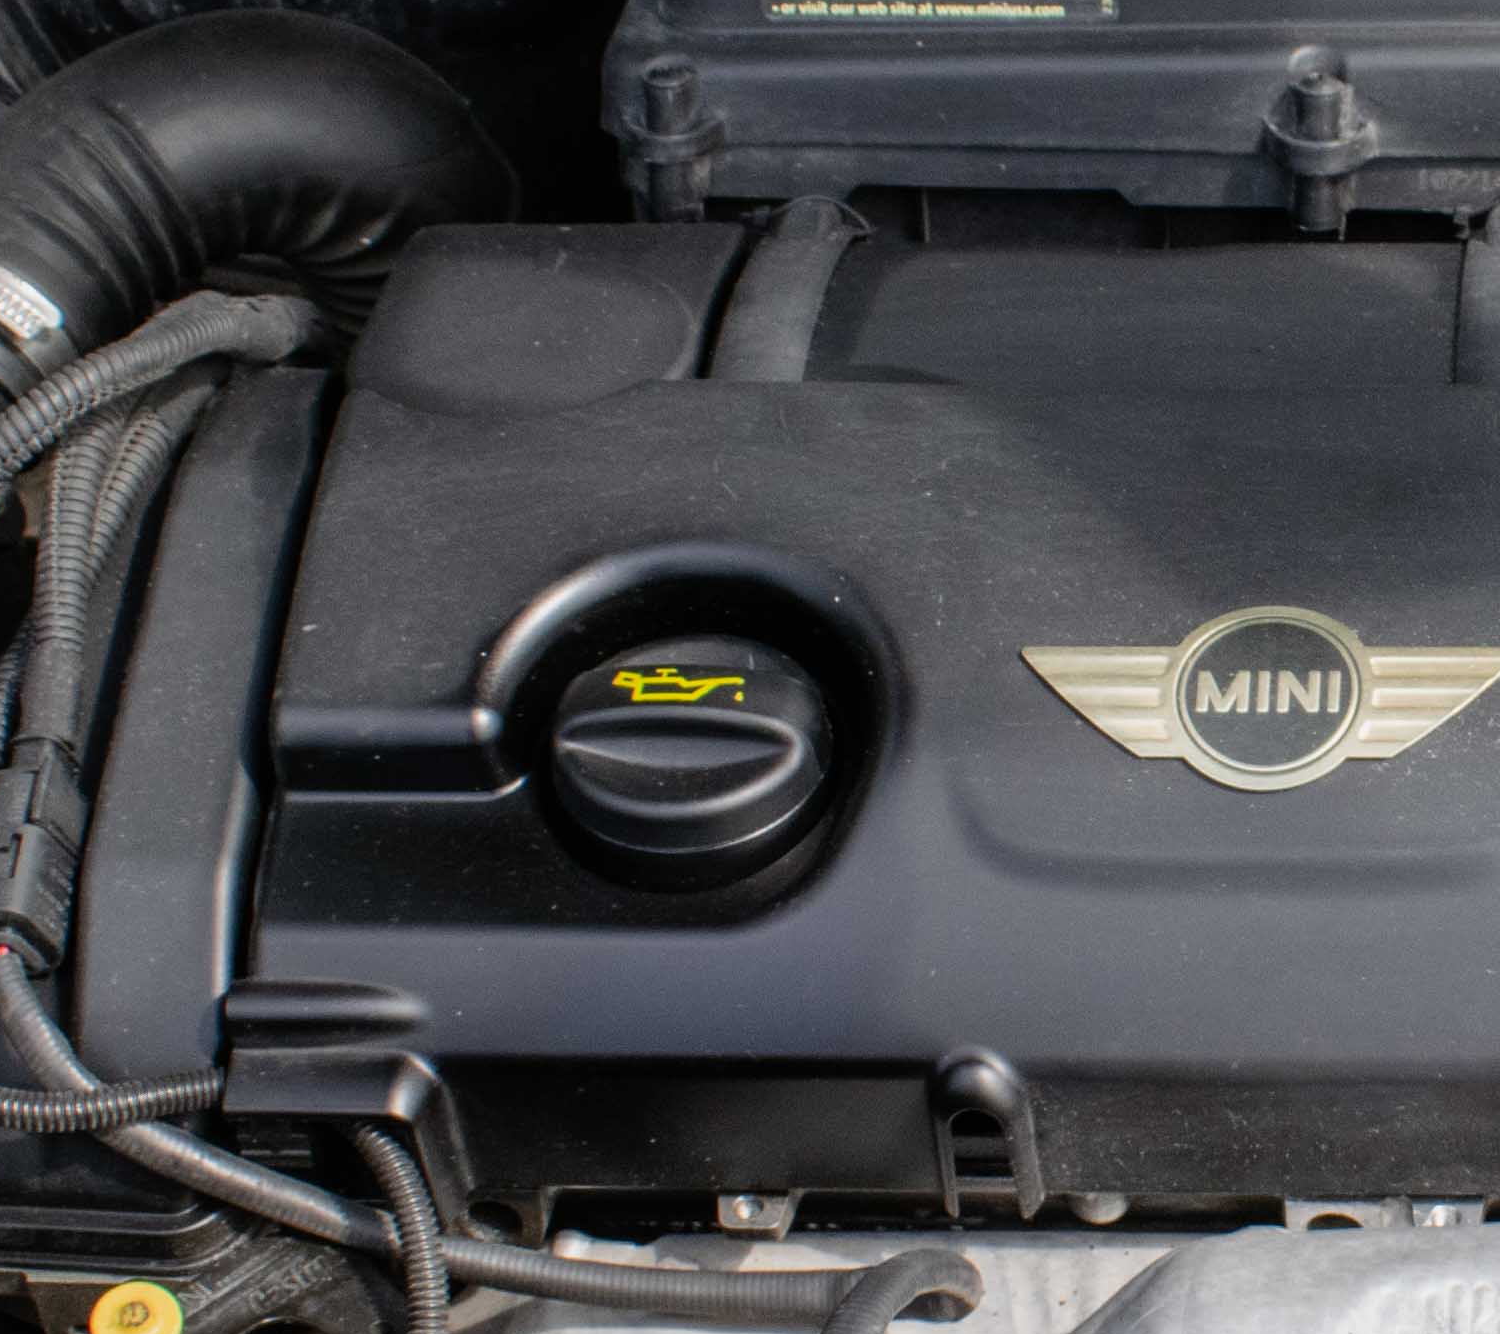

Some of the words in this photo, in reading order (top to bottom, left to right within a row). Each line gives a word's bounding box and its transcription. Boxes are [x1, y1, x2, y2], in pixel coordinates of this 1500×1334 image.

[781, 3, 797, 16] or
[798, 1, 828, 16] visit
[830, 3, 855, 16] our
[857, 2, 887, 16] web
[889, 1, 916, 16] site
[917, 2, 932, 16] at
[934, 2, 1065, 17] www.miniusa.com
[1193, 669, 1342, 714] MINI
